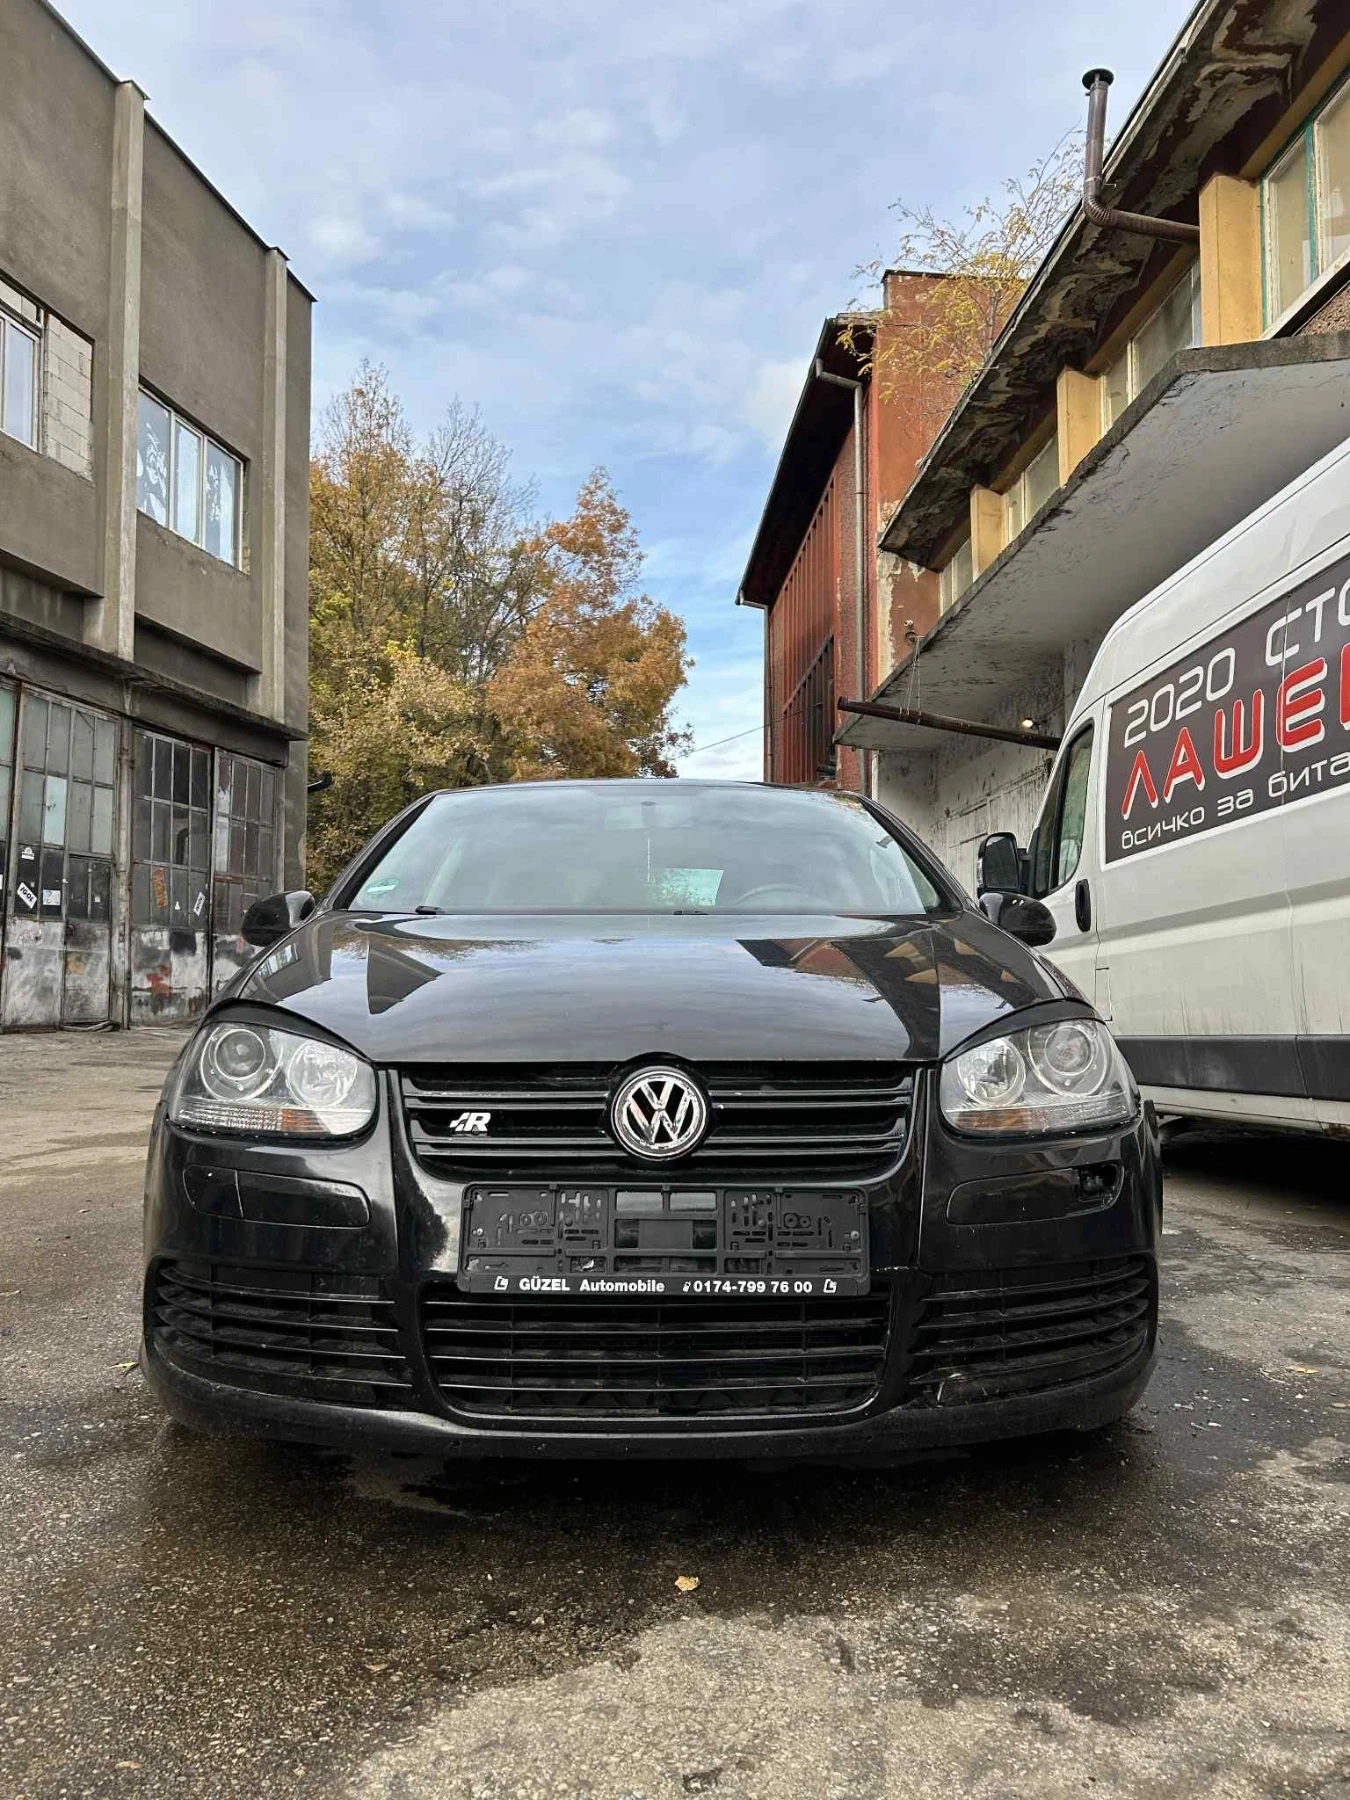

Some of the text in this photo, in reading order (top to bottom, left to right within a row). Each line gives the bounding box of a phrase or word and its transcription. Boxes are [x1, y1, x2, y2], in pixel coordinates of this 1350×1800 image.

[1121, 642, 1350, 820] ЛАШЕ
[1124, 648, 1235, 748] 2020
[1121, 806, 1205, 850] всичко
[1217, 788, 1254, 817] за
[618, 1075, 701, 1150] VW
[519, 1276, 813, 1293] GÜZEL Automobile 0174-799 76 00
